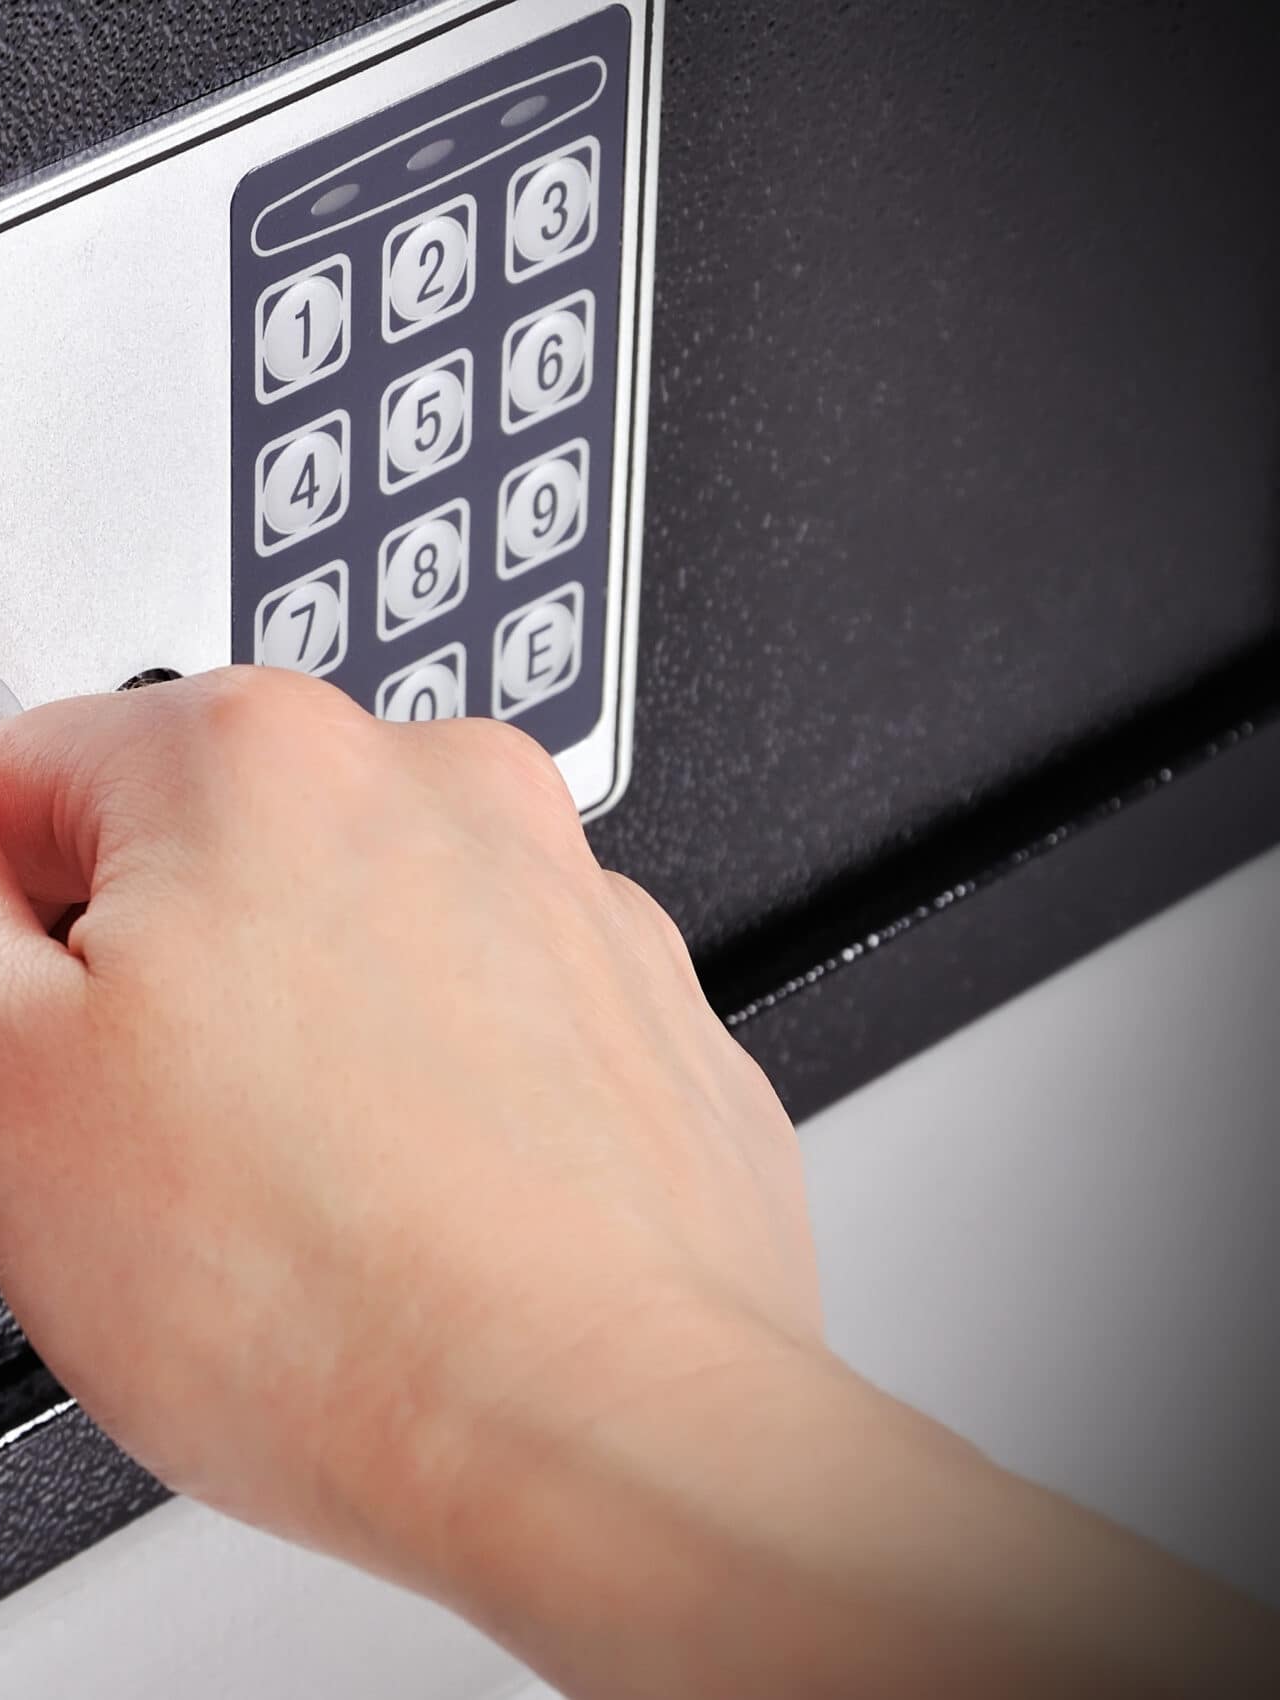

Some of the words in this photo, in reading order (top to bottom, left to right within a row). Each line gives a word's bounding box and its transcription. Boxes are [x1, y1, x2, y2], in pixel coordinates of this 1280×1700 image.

[541, 181, 568, 240] 3
[417, 240, 444, 303] 2
[295, 300, 310, 359] 1
[538, 334, 562, 390] 6
[415, 391, 441, 451] 5
[290, 453, 320, 509] 4
[533, 483, 557, 538] 9
[412, 544, 438, 598] 8
[291, 602, 315, 661] 7
[527, 624, 551, 682] E
